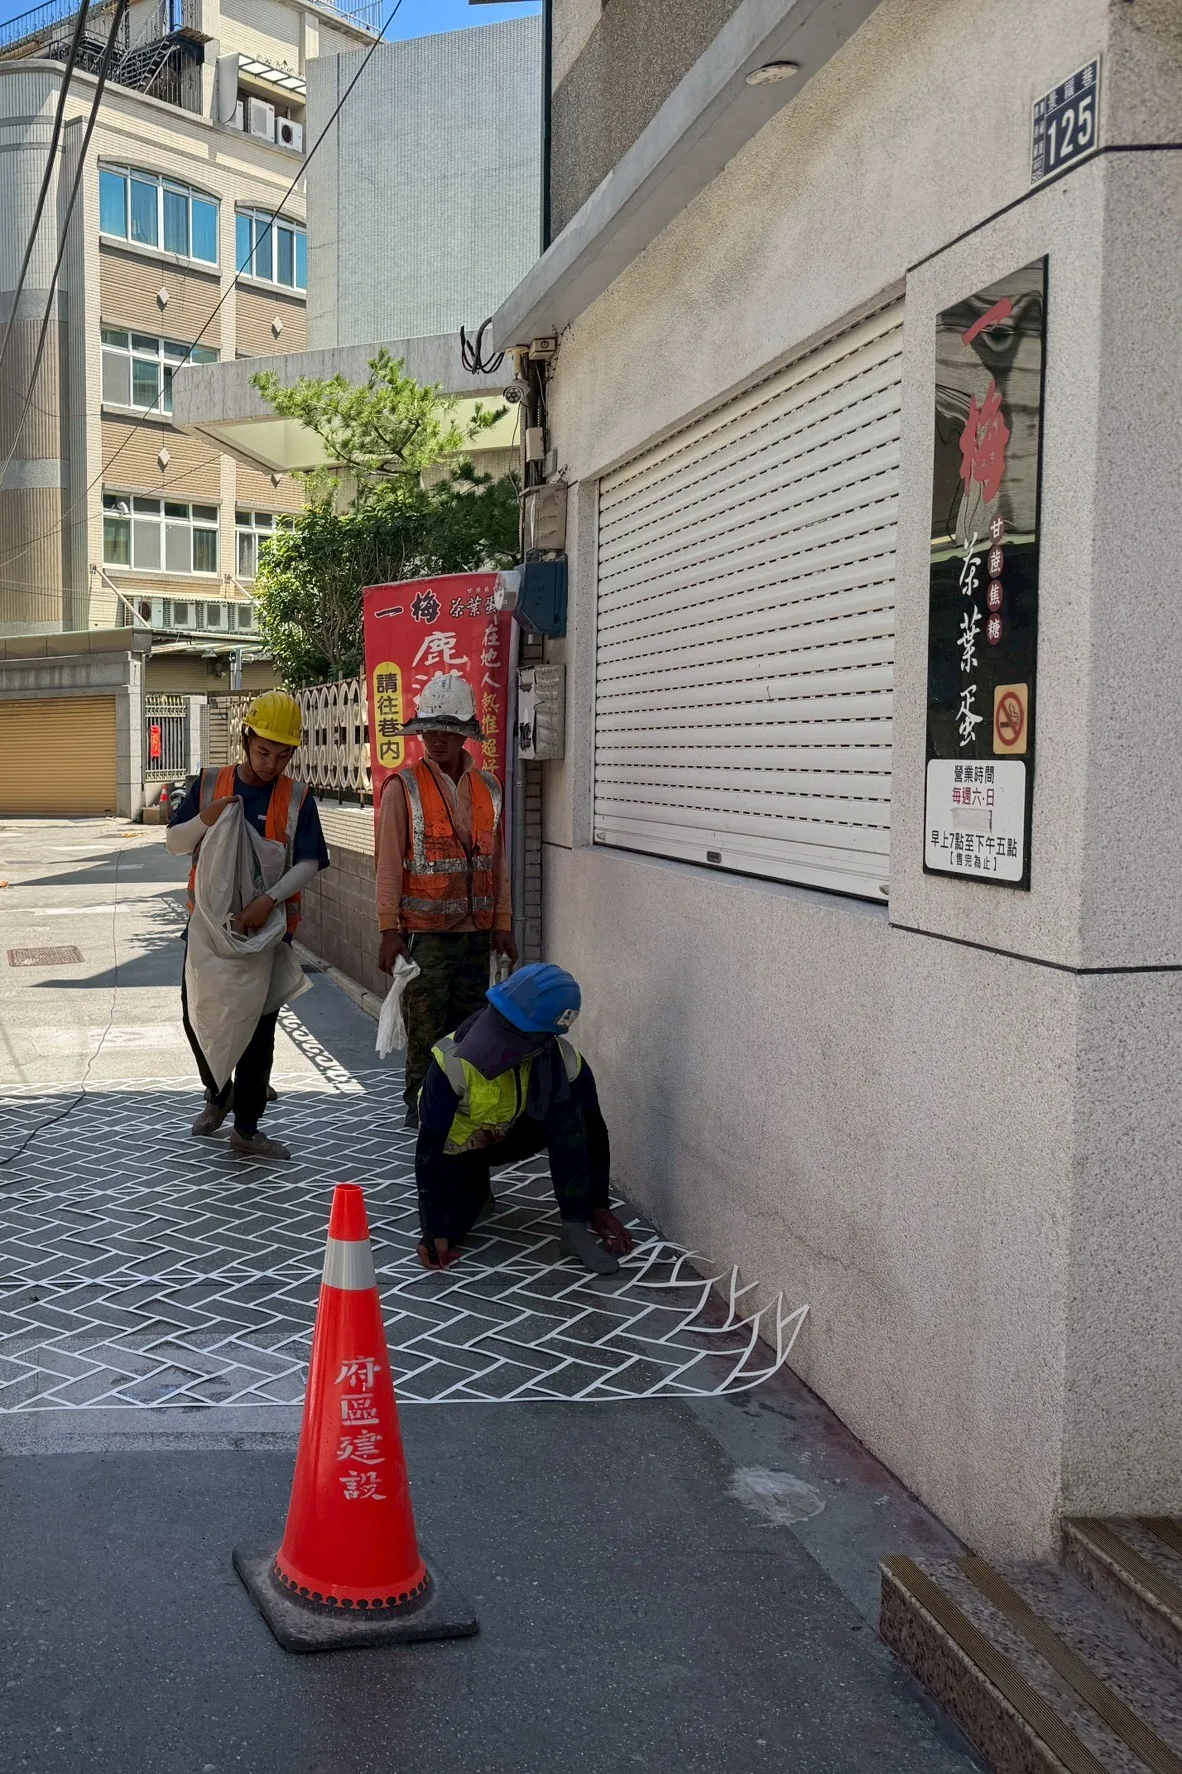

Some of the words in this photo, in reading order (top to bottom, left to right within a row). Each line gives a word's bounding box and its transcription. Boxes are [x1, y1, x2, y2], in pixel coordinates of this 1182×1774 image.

[1047, 95, 1092, 166] 125
[374, 589, 442, 624] 一梅
[955, 531, 983, 747] 茶葉蛋
[376, 673, 400, 761] 請往巷內
[953, 765, 995, 784] 營業時間
[930, 830, 1018, 858] 早上7點至下午五點
[334, 1355, 387, 1500] 府區建設
